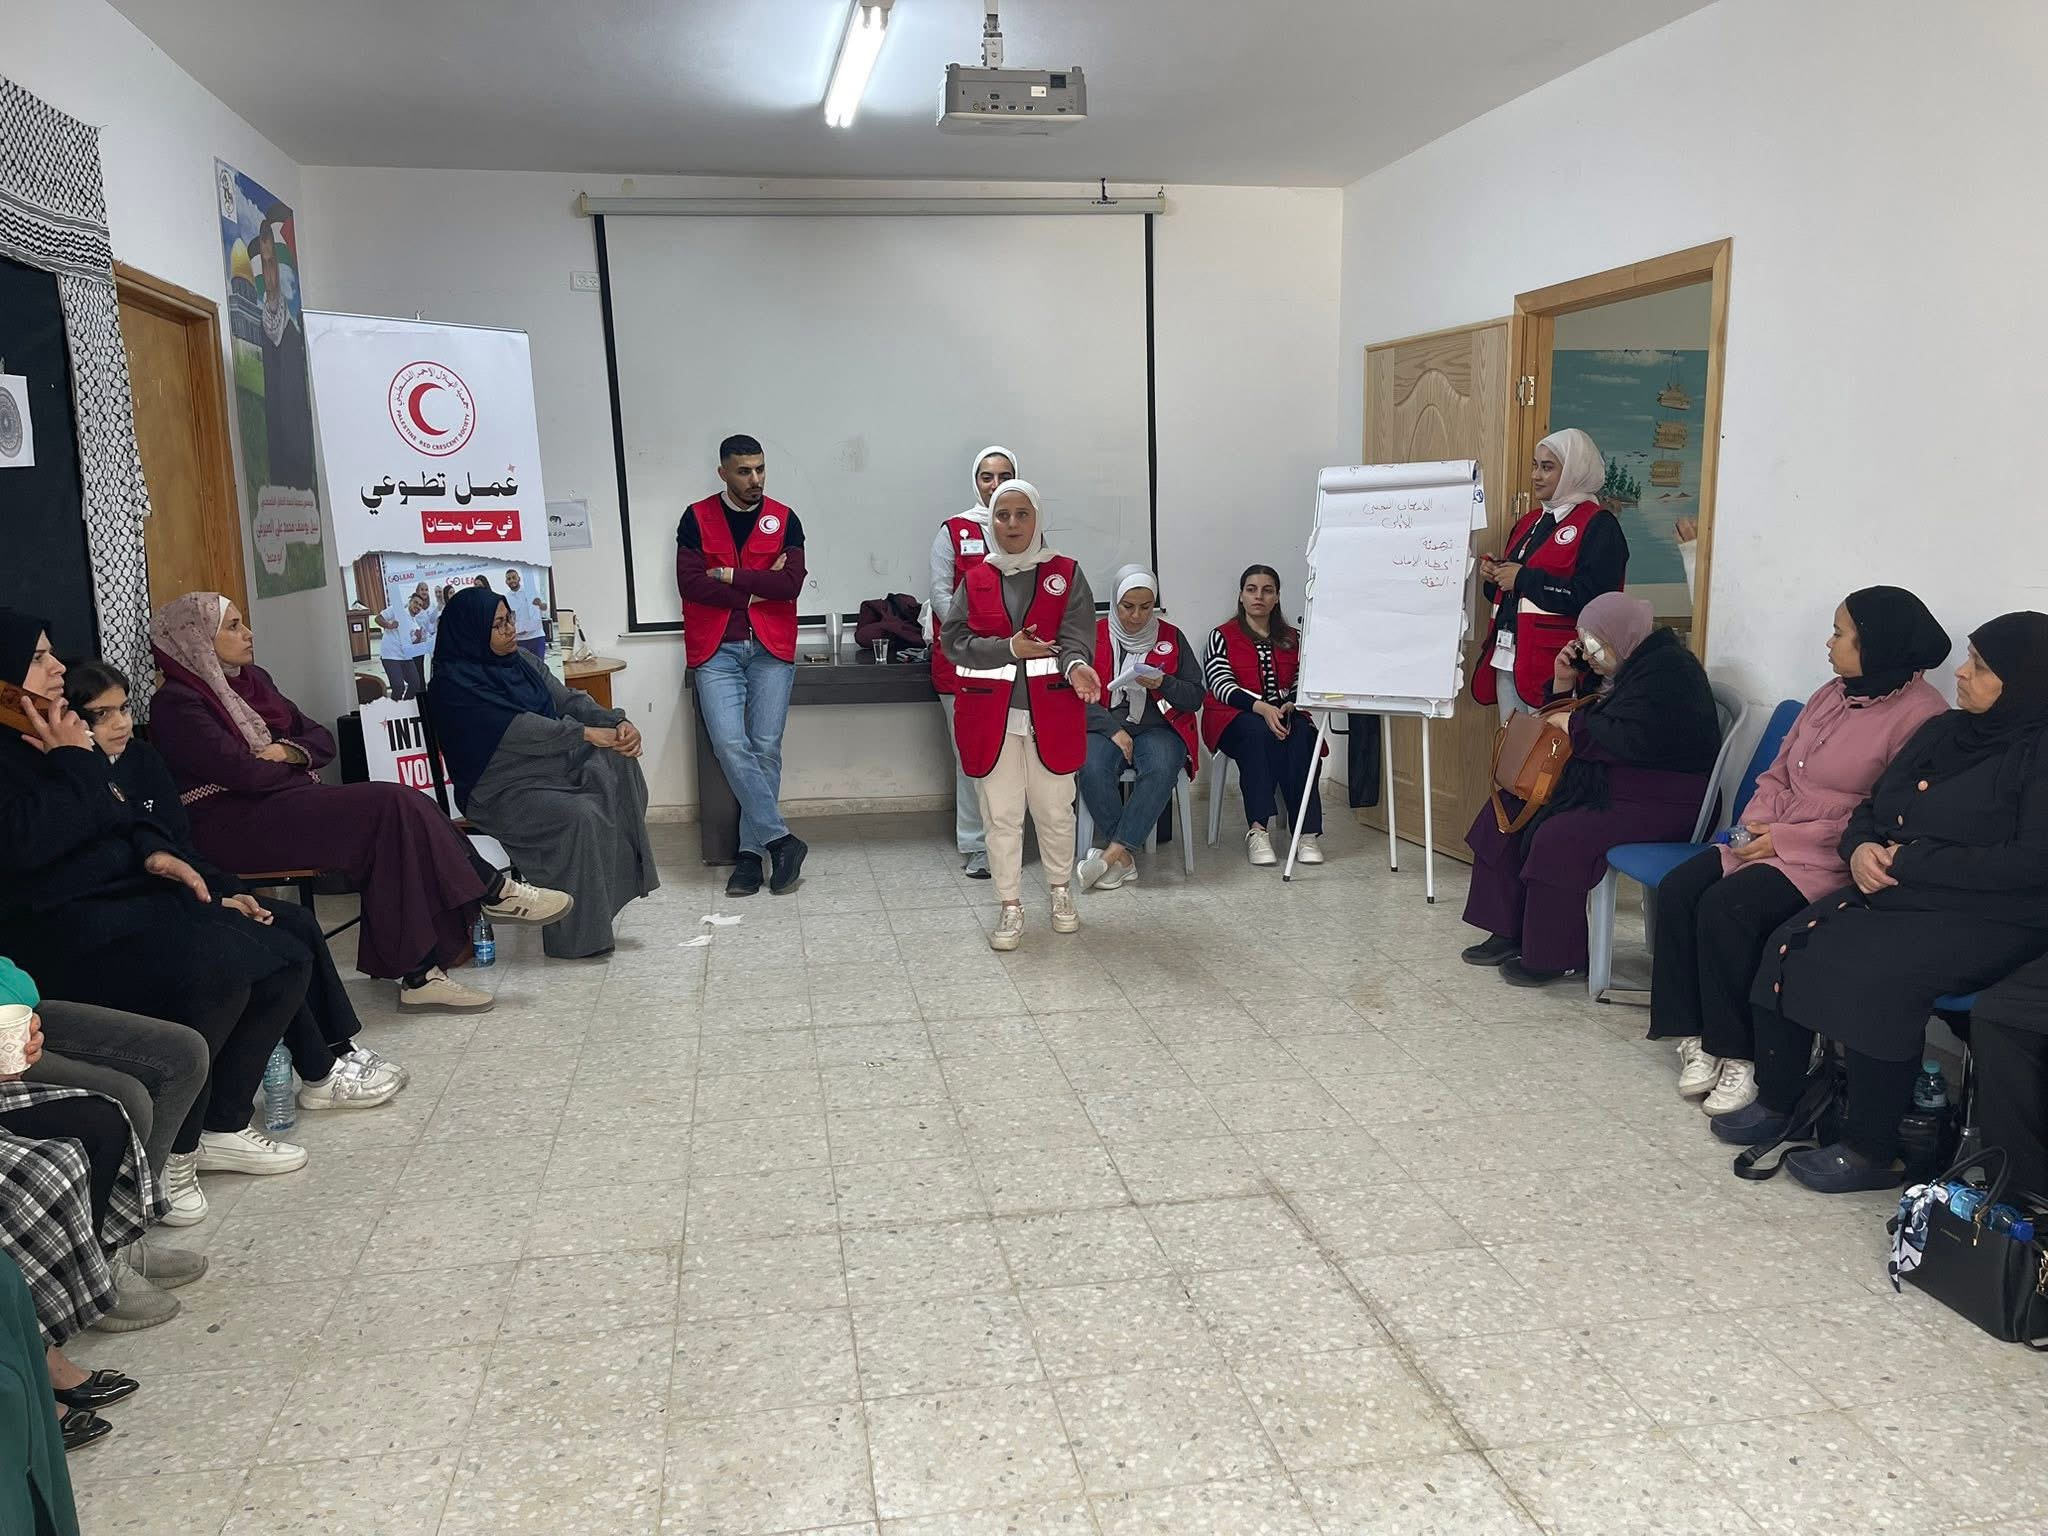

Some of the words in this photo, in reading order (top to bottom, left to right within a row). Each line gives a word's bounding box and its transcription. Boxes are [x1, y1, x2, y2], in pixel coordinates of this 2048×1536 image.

[435, 370, 458, 389] الهلال
[396, 409, 417, 441] PALESTINE
[419, 440, 431, 449] RED
[432, 437, 460, 451] CRESCENT
[458, 413, 470, 438] SOCIETY
[361, 471, 446, 515] تطوعي
[455, 472, 518, 505] عمل
[426, 517, 462, 533] مكان
[465, 517, 493, 535] كل
[496, 516, 513, 539] في
